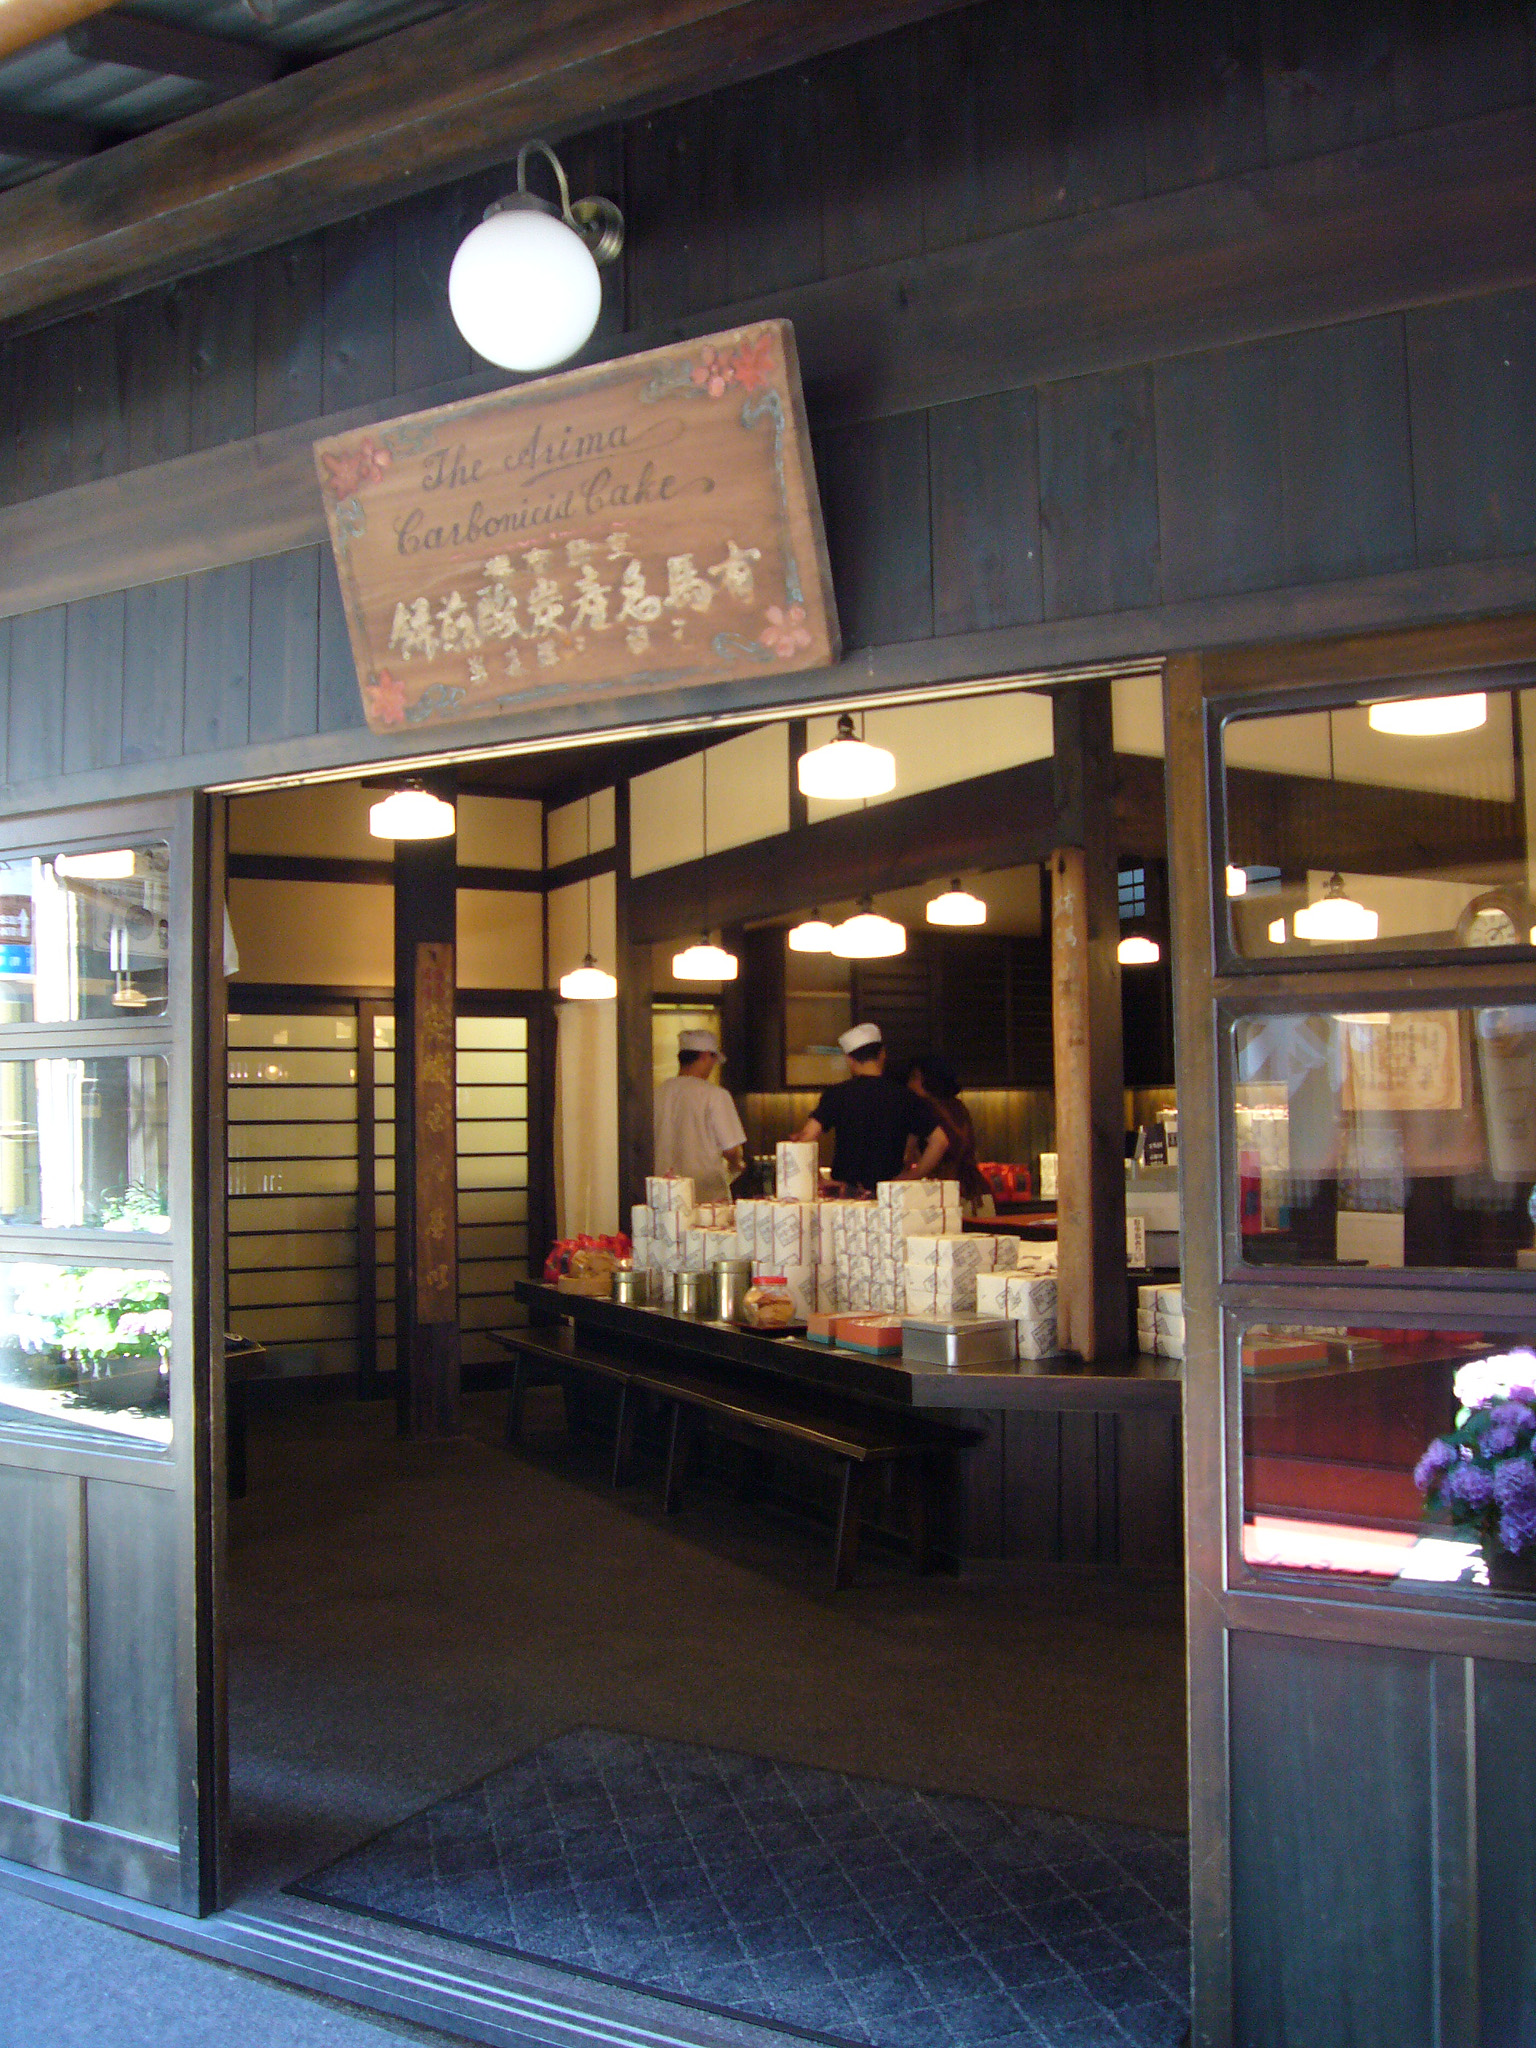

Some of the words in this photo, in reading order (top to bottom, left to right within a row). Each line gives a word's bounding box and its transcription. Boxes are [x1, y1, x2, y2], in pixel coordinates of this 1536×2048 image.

[421, 444, 482, 492] The
[504, 421, 650, 474] Arima
[580, 460, 700, 516] Cake
